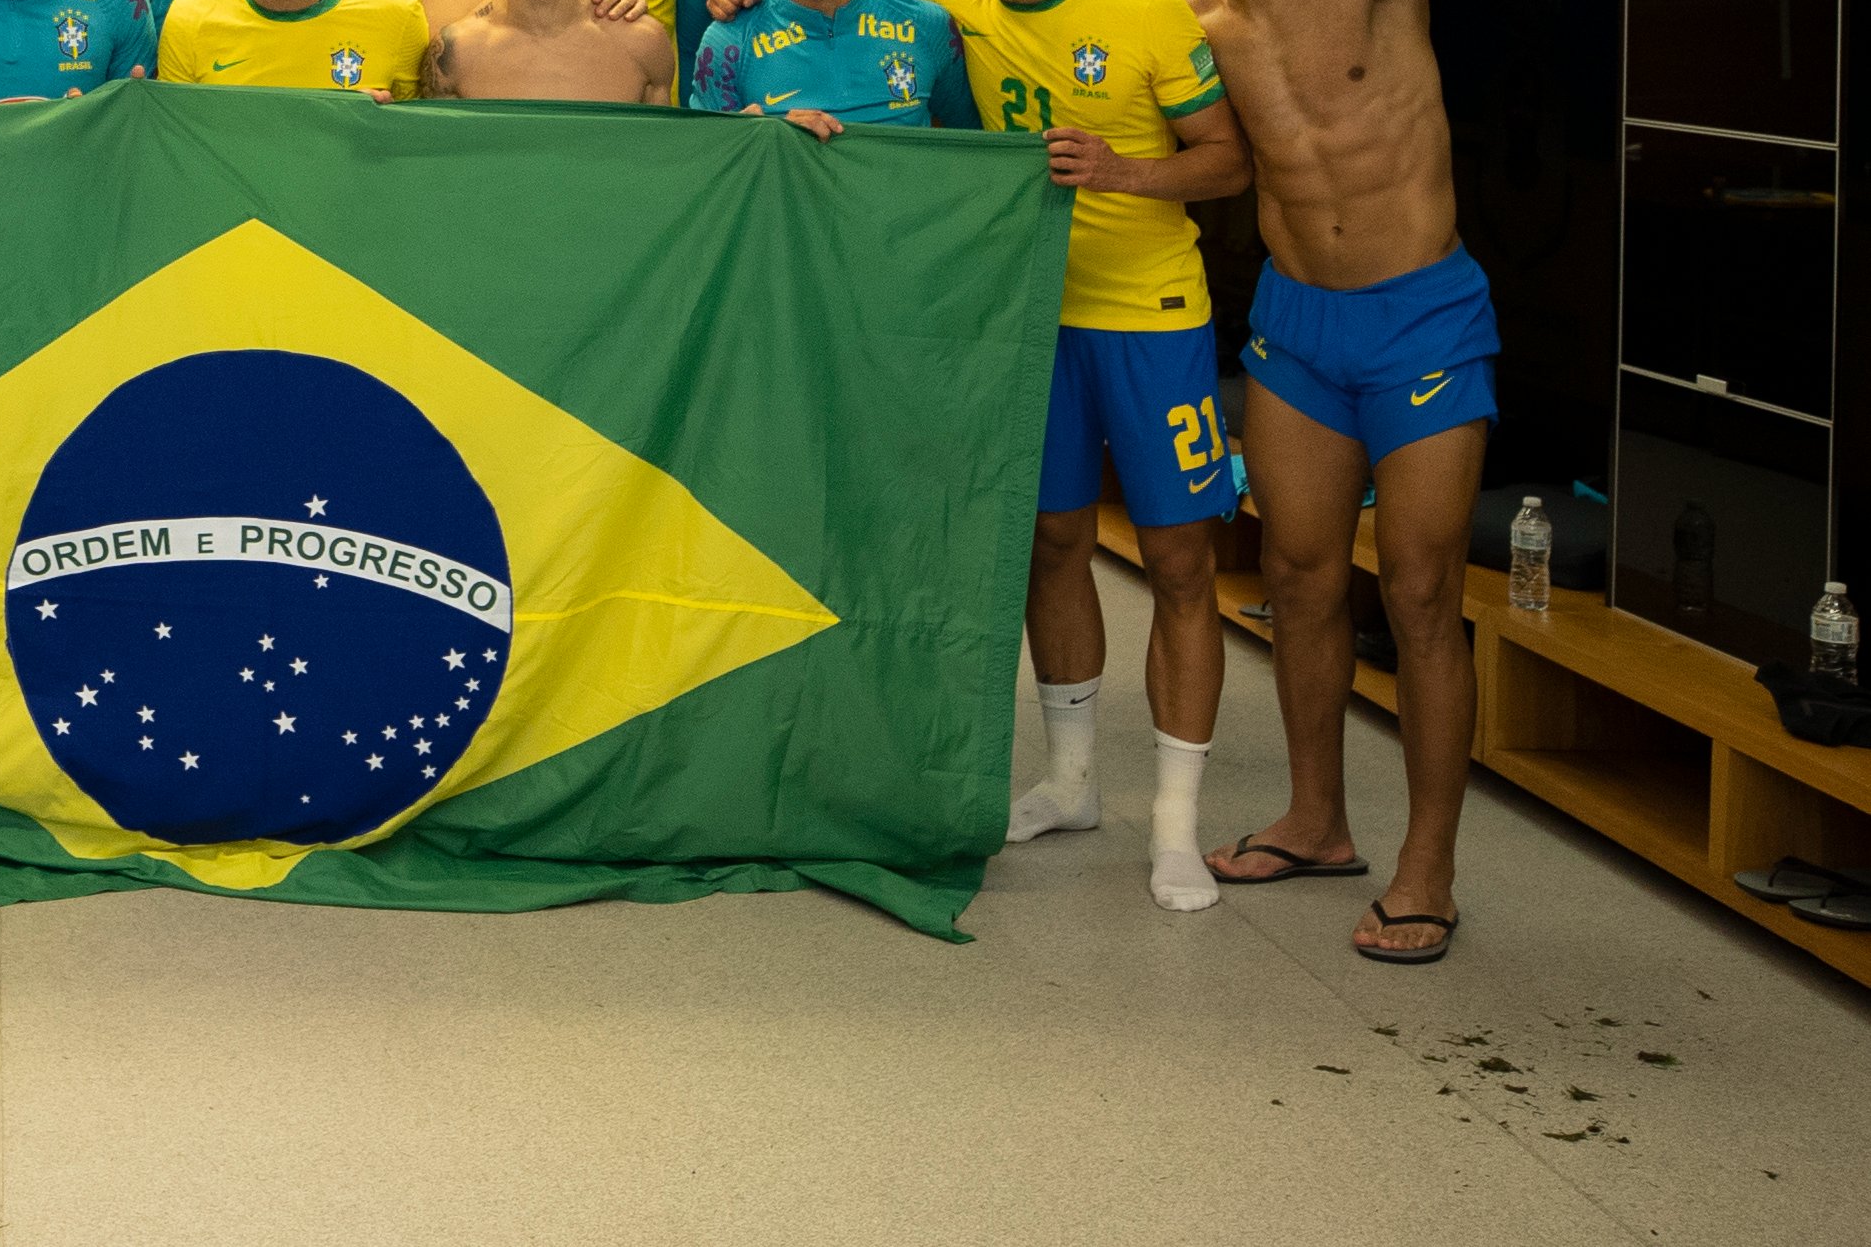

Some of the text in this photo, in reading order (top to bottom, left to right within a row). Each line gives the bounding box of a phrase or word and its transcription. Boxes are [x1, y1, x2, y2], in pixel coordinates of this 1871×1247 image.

[752, 20, 808, 59] Itaú
[858, 13, 916, 44] Itaú
[58, 61, 93, 72] BRASIL
[714, 45, 740, 112] vivo
[1000, 76, 1053, 133] 21
[1072, 88, 1112, 101] BRASIL
[1166, 395, 1225, 471] 21
[22, 524, 499, 613] ORDEM E PROGRESSO
